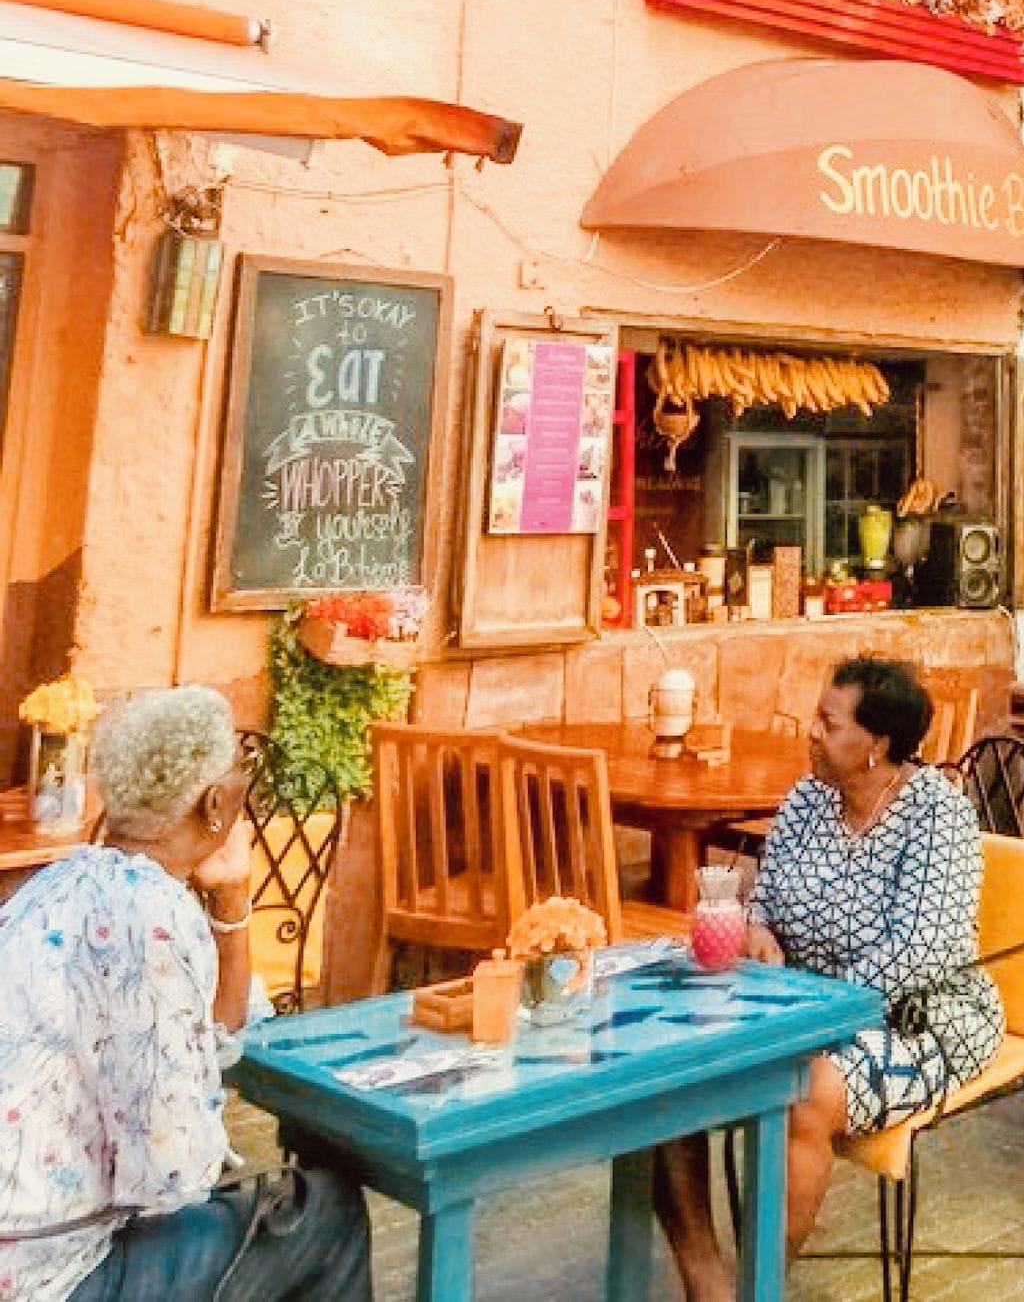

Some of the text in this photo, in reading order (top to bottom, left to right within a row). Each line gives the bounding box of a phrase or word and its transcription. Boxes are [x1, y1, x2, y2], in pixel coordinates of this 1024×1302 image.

[816, 144, 998, 230] Smoothie
[294, 290, 416, 329] IT'S OKAY
[338, 319, 368, 343] to
[281, 456, 388, 516] WHOPPER
